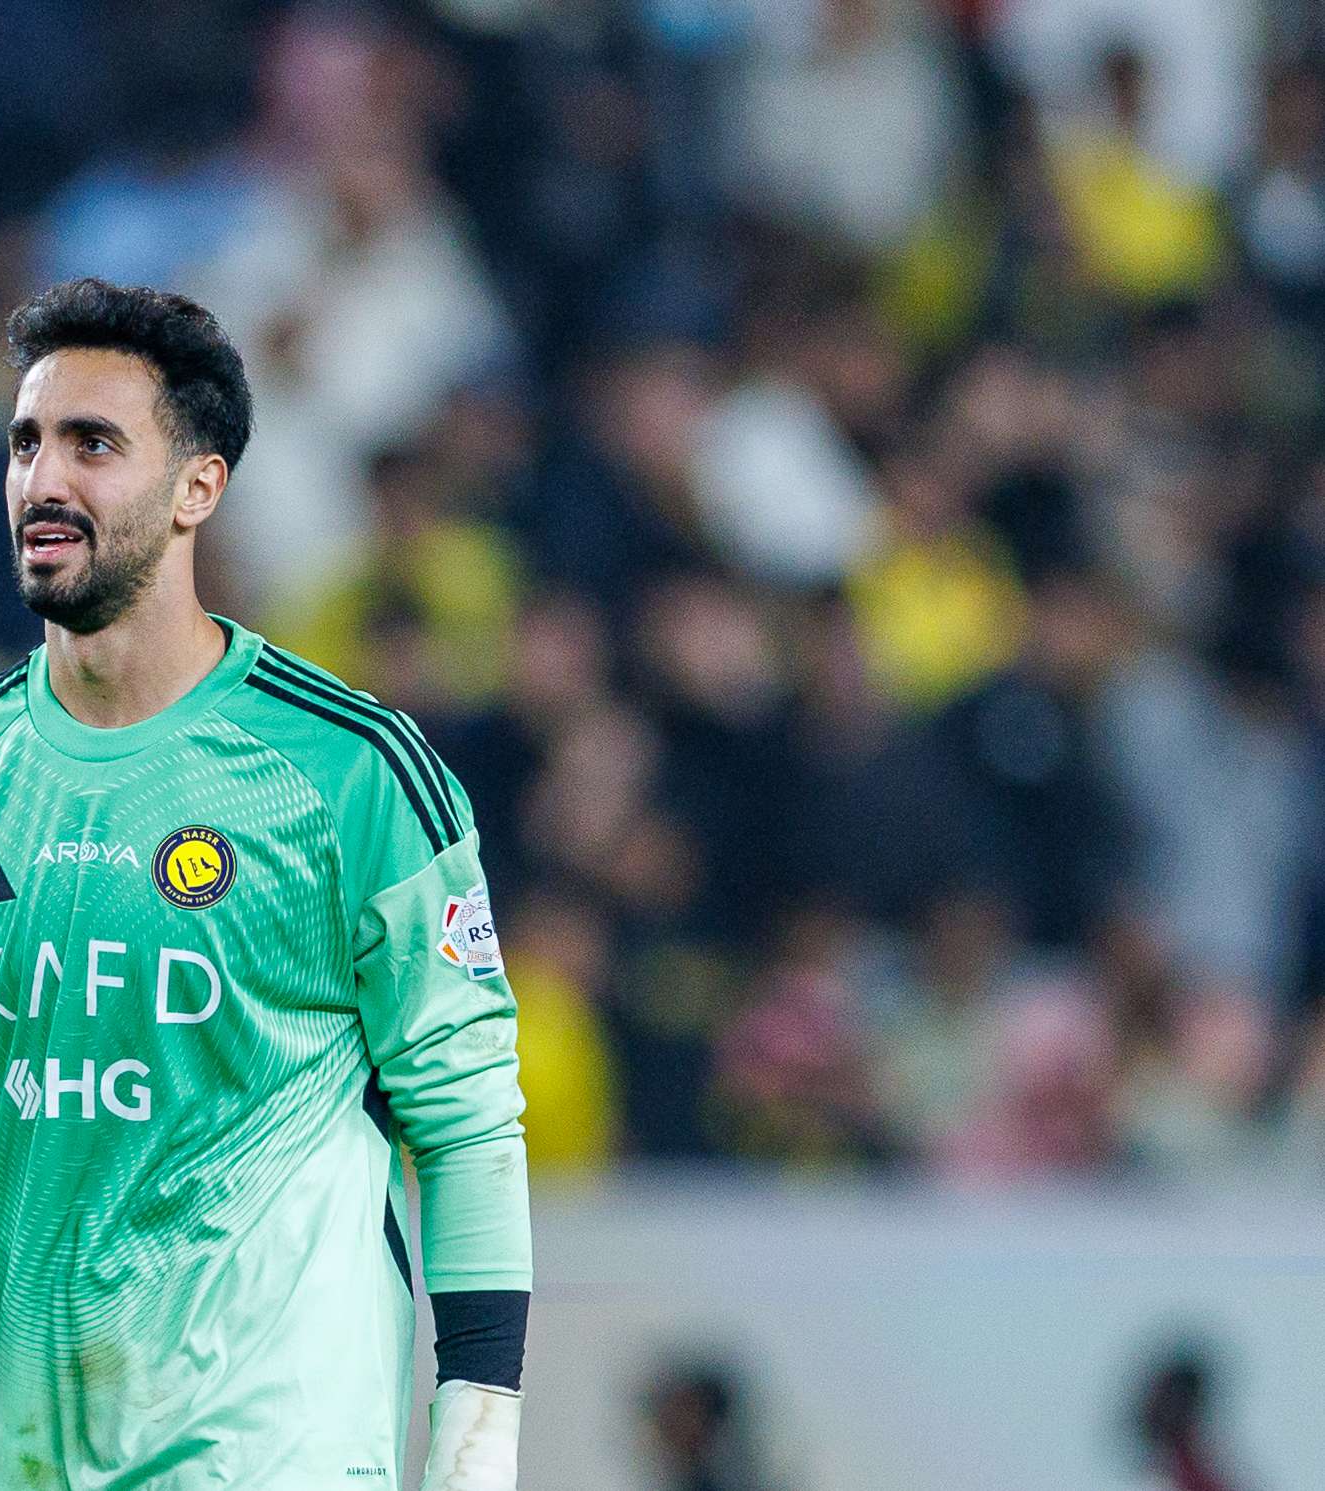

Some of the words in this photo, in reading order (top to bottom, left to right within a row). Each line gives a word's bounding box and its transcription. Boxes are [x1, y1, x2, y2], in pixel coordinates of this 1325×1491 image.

[181, 830, 220, 846] NASSR
[32, 840, 141, 868] AROYA
[165, 885, 193, 904] RIYADH
[45, 1058, 152, 1122] HG
